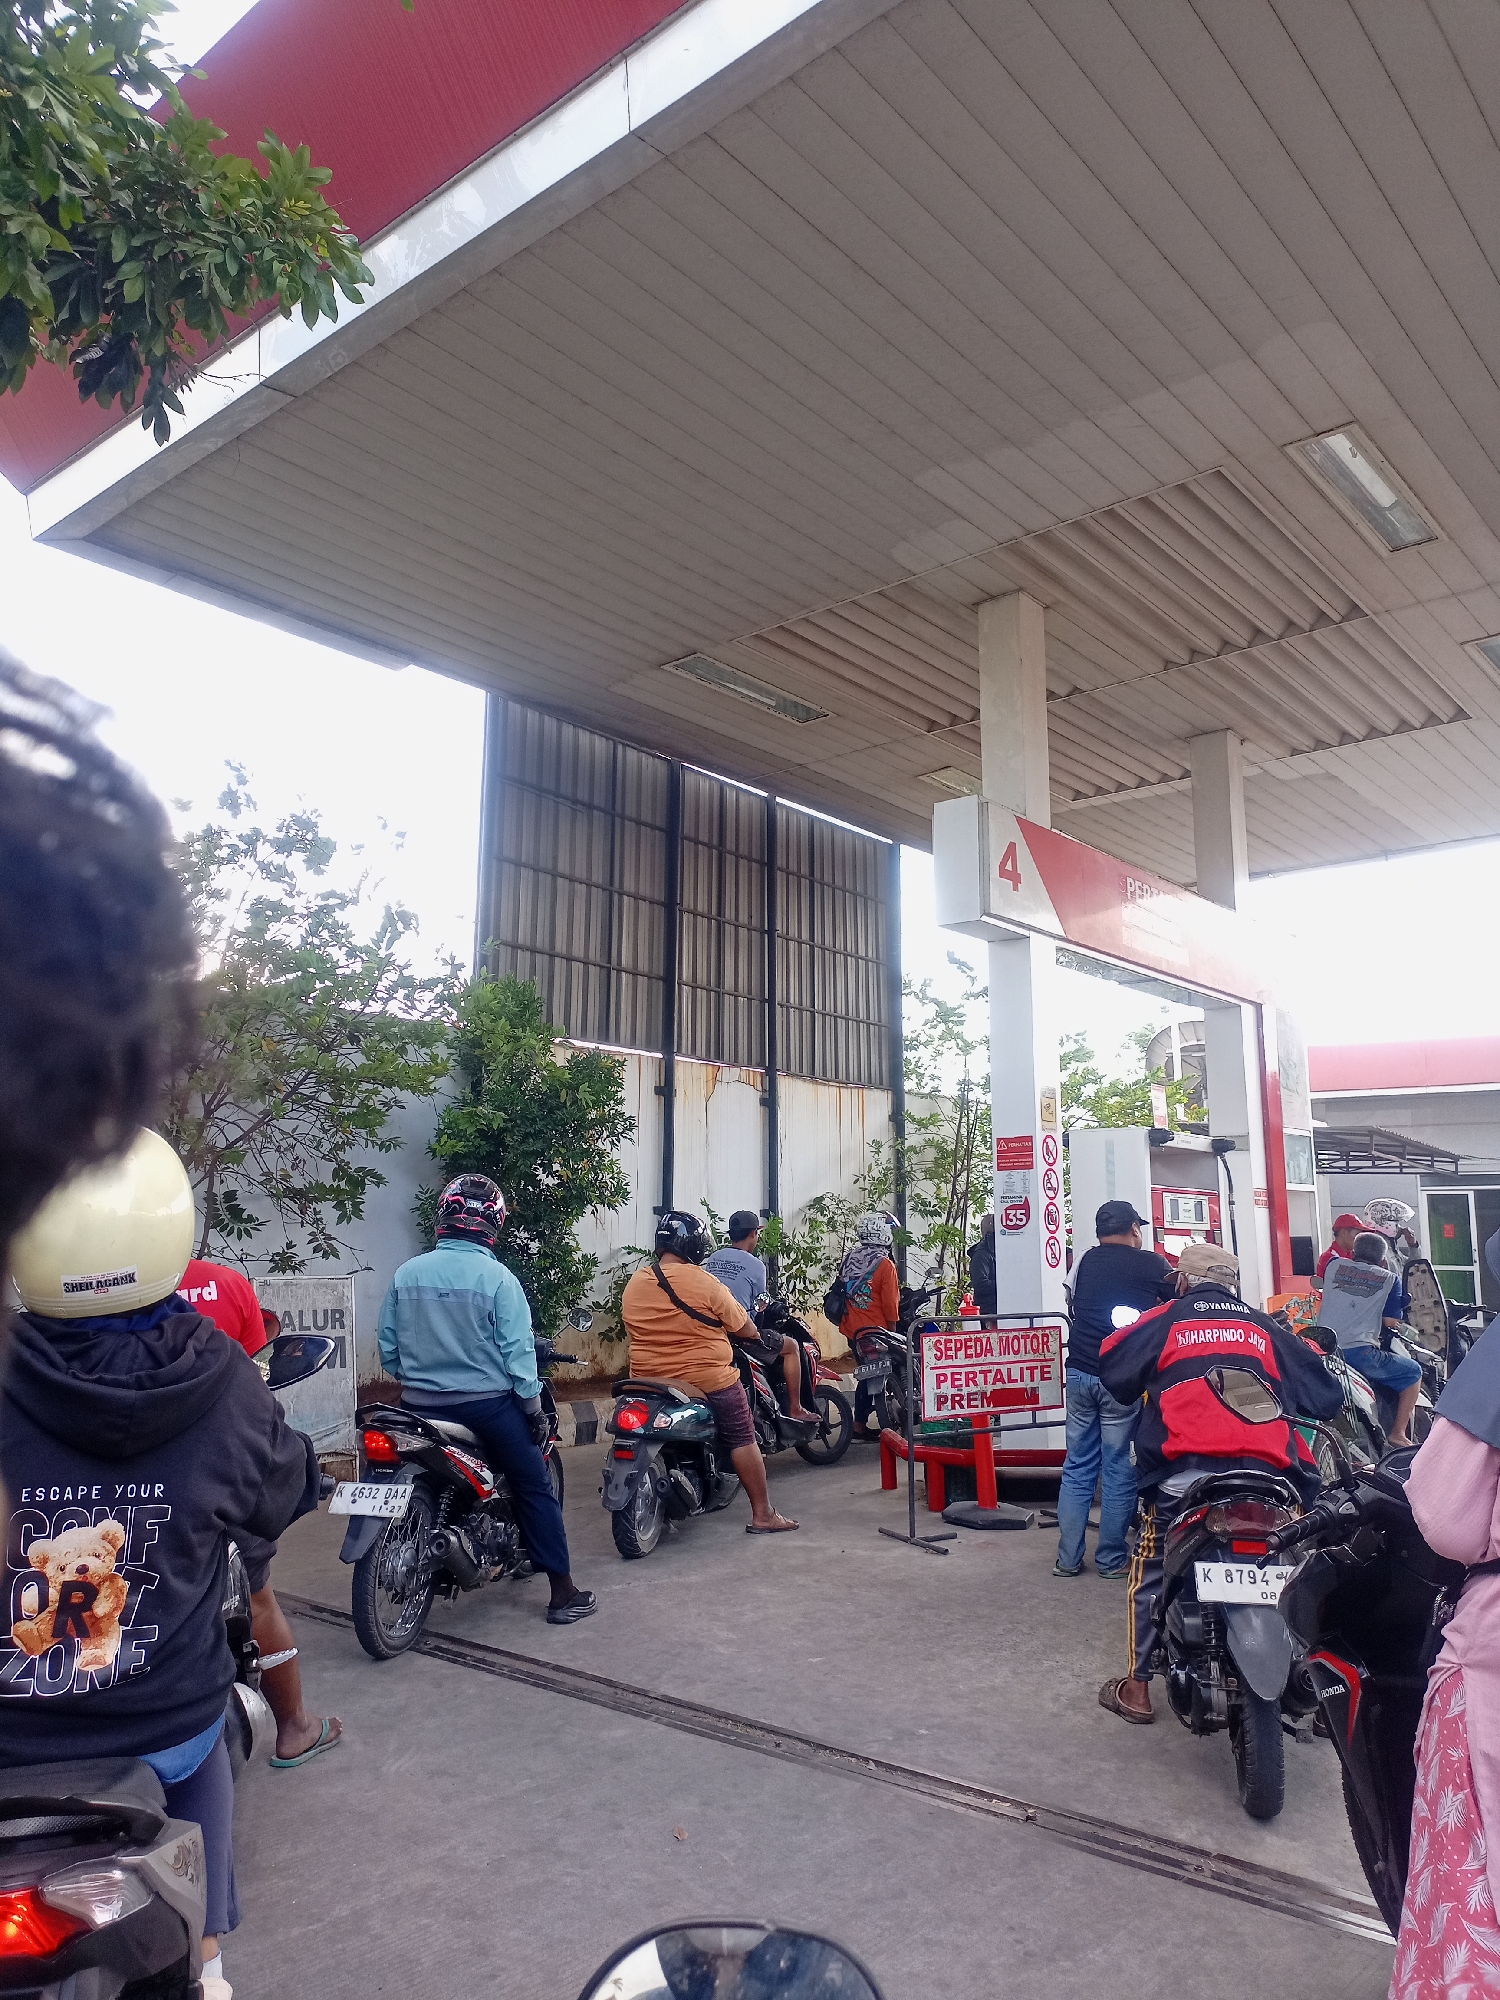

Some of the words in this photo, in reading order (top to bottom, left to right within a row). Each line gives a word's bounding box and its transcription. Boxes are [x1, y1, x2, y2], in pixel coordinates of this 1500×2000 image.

[998, 841, 1022, 892] 4
[1002, 1209, 1026, 1226] 135
[1209, 1302, 1250, 1314] YAMAHA
[275, 1308, 346, 1332] ALUR
[933, 1336, 994, 1362] SEPEDA
[998, 1332, 1050, 1357] MOTOR
[1190, 1328, 1245, 1345] HARPINDO
[1248, 1331, 1266, 1354] JAYA
[935, 1365, 1052, 1390] PERTALITE
[21, 1485, 102, 1502] ESCAPE
[114, 1483, 165, 1499] YOUR
[336, 1486, 344, 1499] K
[384, 1487, 408, 1501] DAA
[6, 1504, 172, 1571] COMF
[1202, 1567, 1213, 1583] K
[1224, 1569, 1270, 1586] 8794
[1260, 1591, 1277, 1600] 08
[0, 1625, 159, 1697] ZONE
[1321, 1684, 1346, 1698] HONDA
